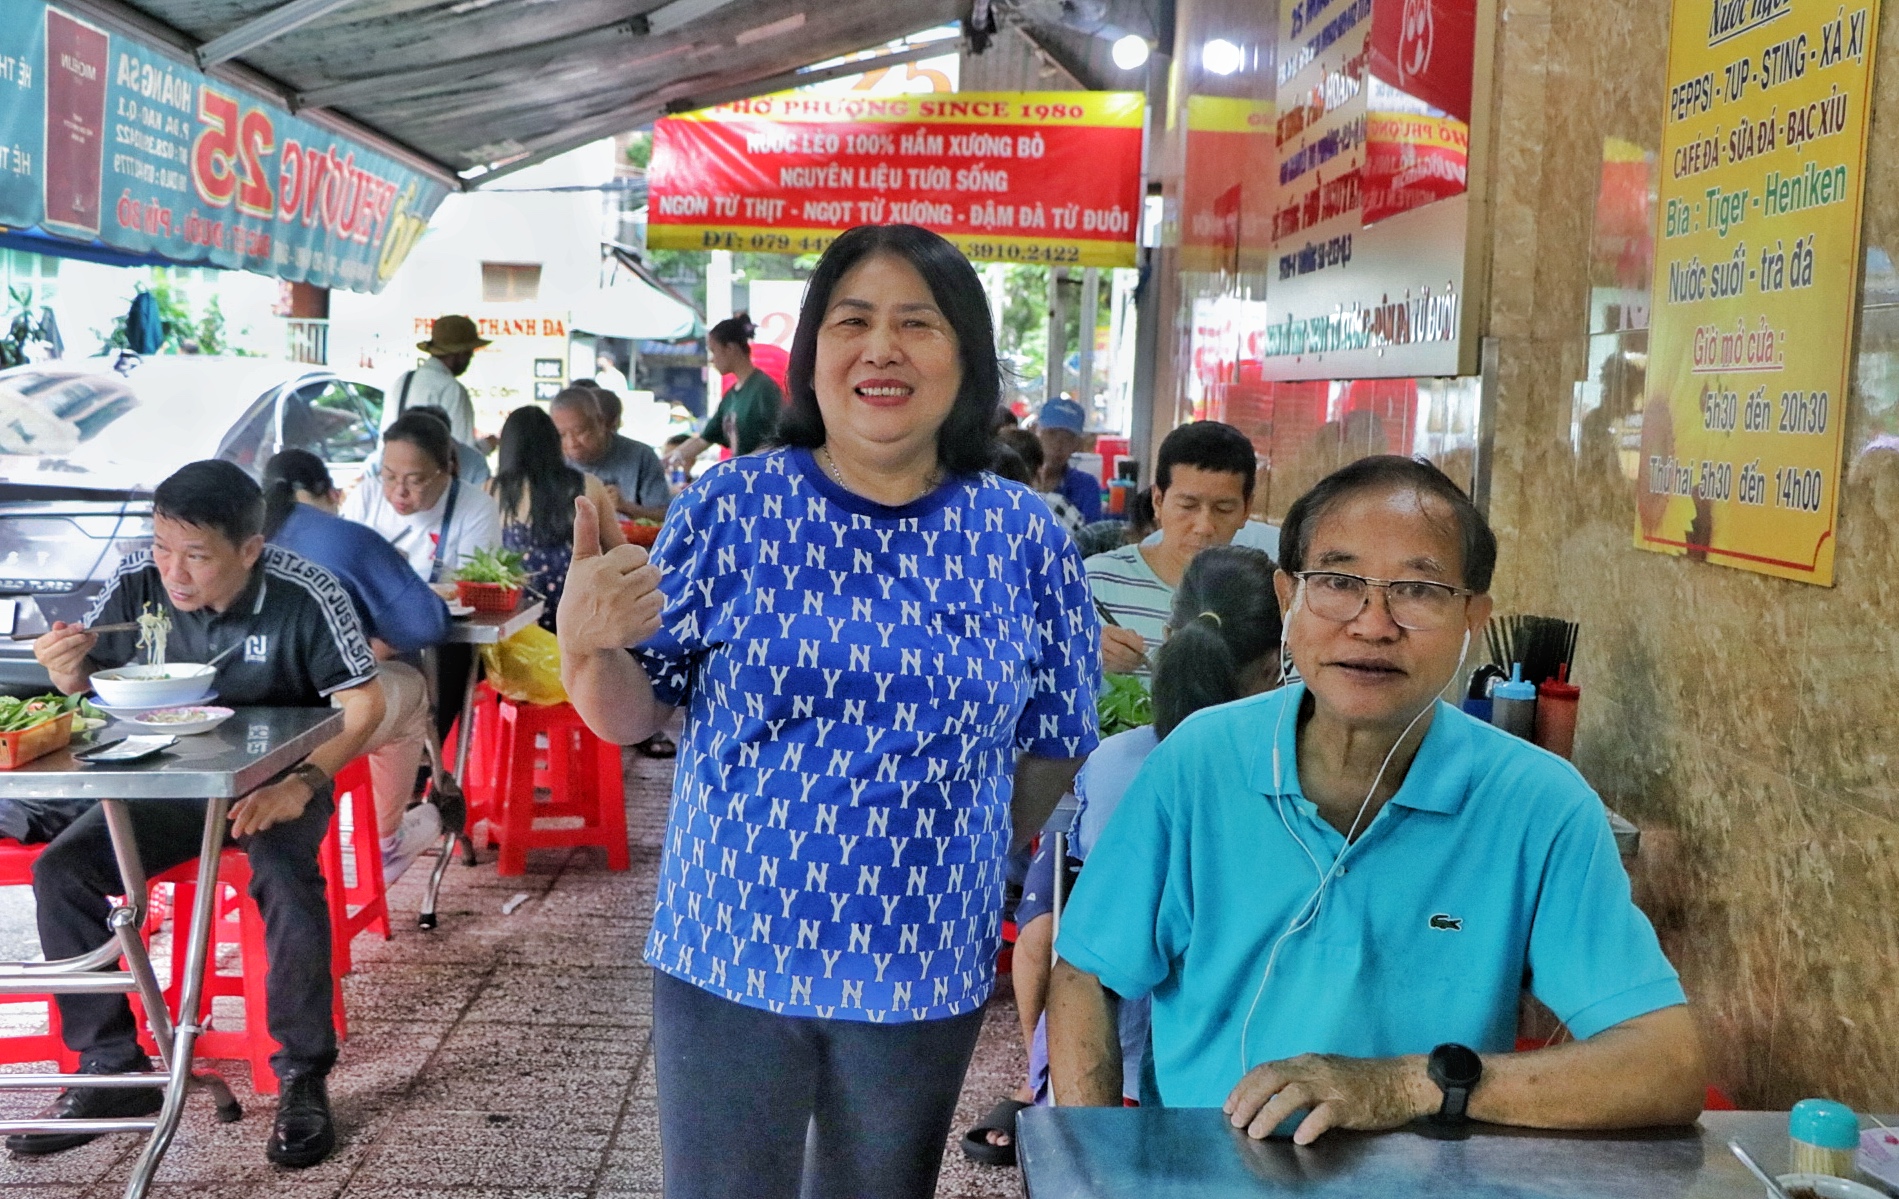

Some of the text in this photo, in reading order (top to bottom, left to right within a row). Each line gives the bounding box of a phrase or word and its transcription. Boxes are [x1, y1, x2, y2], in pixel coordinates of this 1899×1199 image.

[1723, 58, 1750, 104] 7UP
[1760, 34, 1807, 90] STING
[1819, 7, 1844, 68] XÁ
[1846, 10, 1866, 64] XỊ
[919, 101, 1009, 118] SINCE
[1021, 104, 1084, 120] 1980
[846, 134, 895, 156] 100%
[1017, 131, 1045, 158] BÒ
[1703, 126, 1720, 170] ĐÁ
[1757, 107, 1776, 155] ĐÁ
[1787, 103, 1816, 152] BẠC
[780, 161, 854, 189] NGUYÊN
[858, 163, 902, 192] LIỆU
[955, 162, 1008, 192] SỐNG
[659, 195, 709, 216] NGON
[744, 197, 786, 224] THỊT
[803, 200, 854, 228] NGỌT
[889, 200, 953, 226] XƯƠNG
[970, 200, 1014, 231] ĐẬM
[1019, 202, 1046, 229] ĐÀ
[1083, 205, 1129, 233] ĐUÔI
[1666, 161, 1847, 238] Bia Tiger Heniken
[751, 236, 789, 250] 079
[1710, 243, 1746, 299] suối
[1760, 241, 1785, 292] trà
[1789, 234, 1815, 288] đá
[1693, 325, 1717, 367] Giờ
[1749, 314, 1775, 363] cửa
[1704, 385, 1828, 433] 5h30 đến 20h30
[1674, 460, 1694, 496] hai
[1699, 462, 1732, 500] 5h30
[1738, 457, 1765, 505] đến
[1775, 467, 1822, 512] 14h00
[716, 494, 737, 523] N
[739, 516, 757, 543] Y
[830, 521, 848, 548] Y
[1025, 513, 1046, 544] N
[717, 545, 737, 576] N
[1039, 547, 1056, 576] Y
[696, 577, 715, 608] Y
[829, 570, 848, 595] Y
[746, 638, 820, 668] N N
[770, 665, 894, 702] Y Y Y
[842, 699, 918, 732] N N
[815, 717, 979, 764] Y Y Y Y
[780, 743, 901, 782] N N N
[755, 768, 920, 809] Y Y Y Y
[767, 797, 936, 838] N N N N
[789, 829, 909, 867] Y Y Y
[758, 855, 928, 896] N N N N
[780, 887, 900, 925] Y Y Y
[751, 913, 919, 954] N N N N
[774, 944, 892, 982] Y Y Y
[789, 975, 912, 1012] N N N
